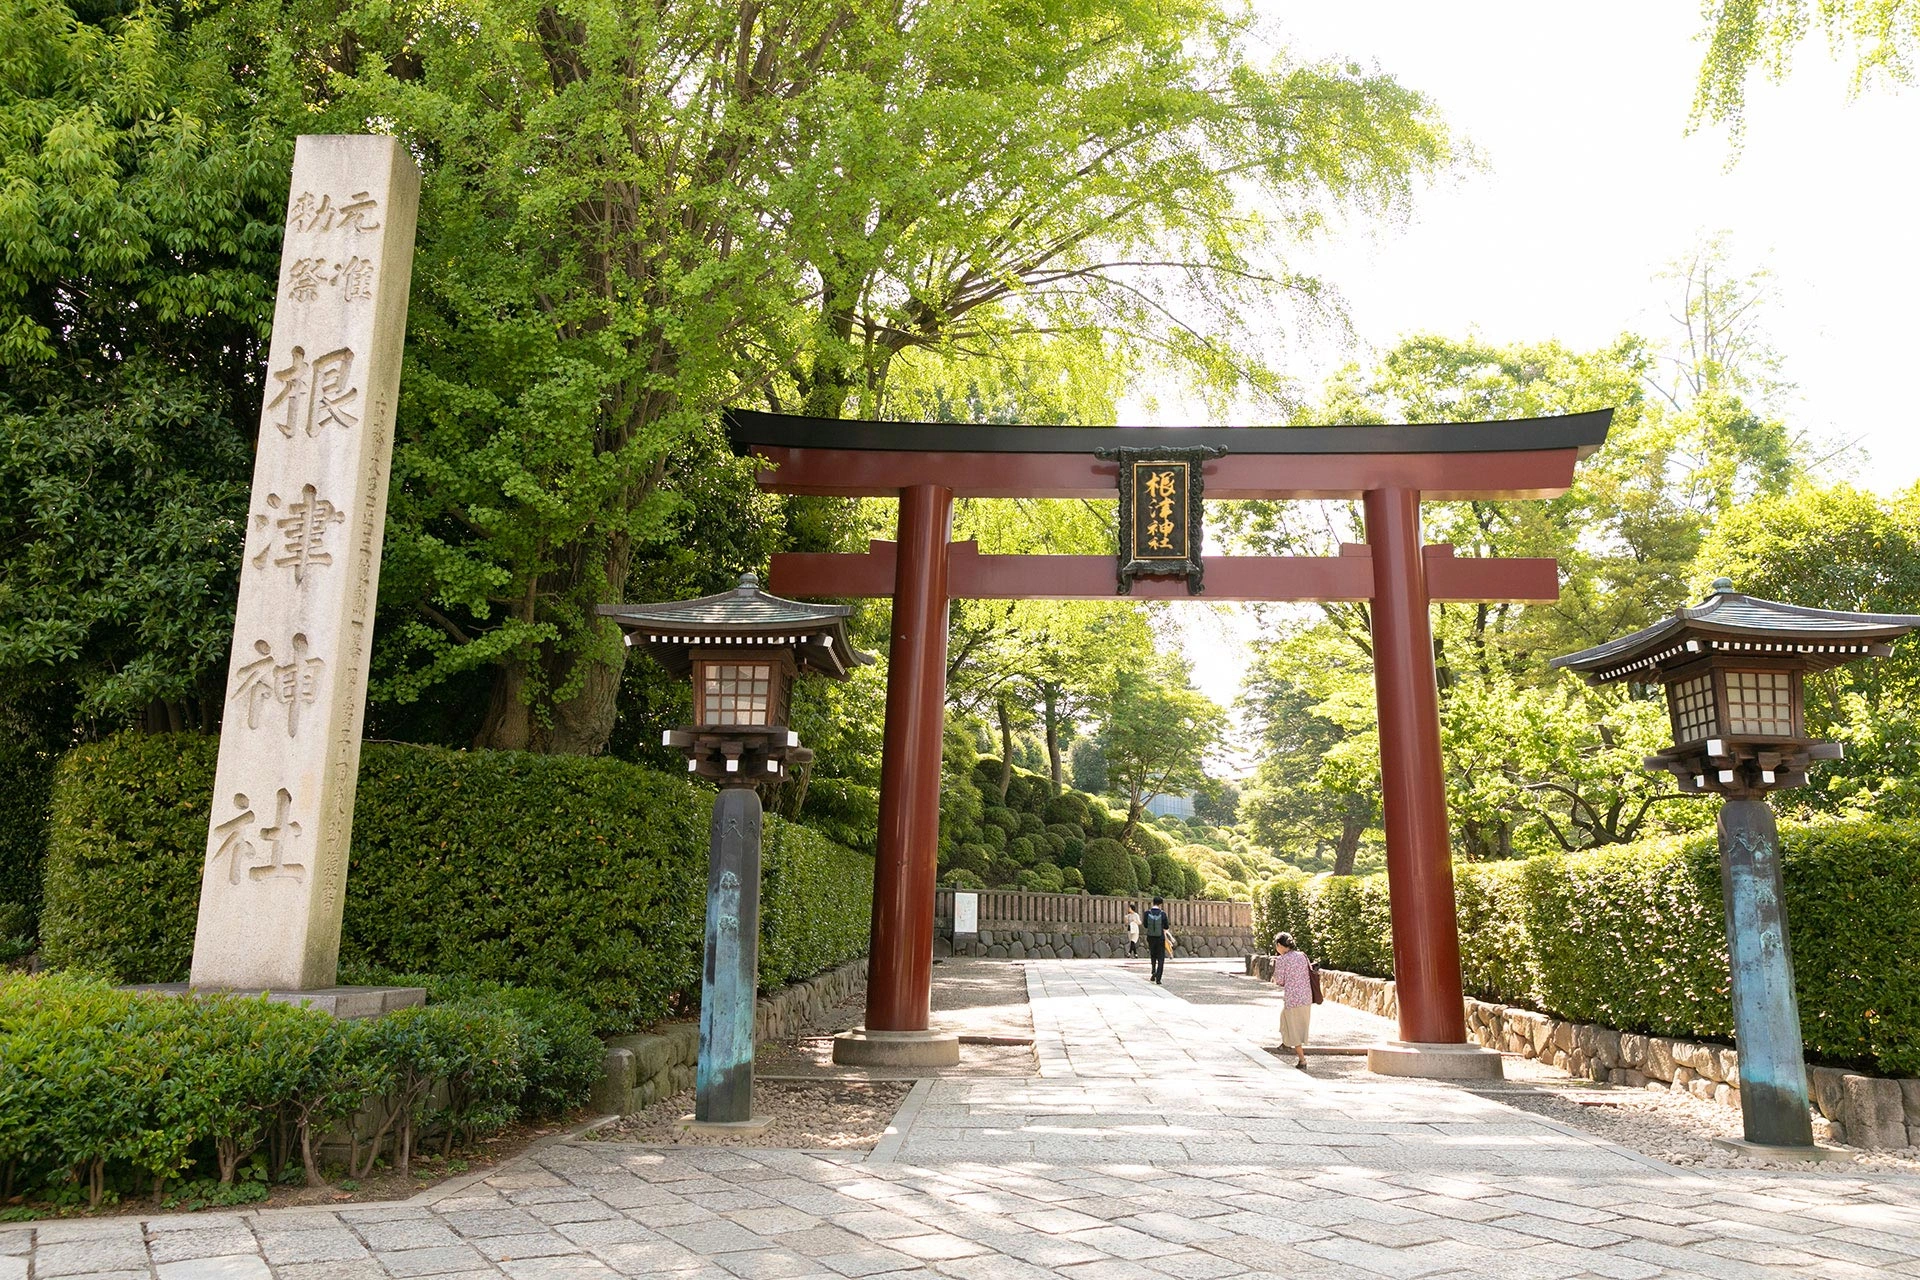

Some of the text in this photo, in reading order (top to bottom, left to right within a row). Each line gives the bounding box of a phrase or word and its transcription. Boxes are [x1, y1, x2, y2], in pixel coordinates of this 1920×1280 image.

[211, 345, 358, 886] 根津神社
[1145, 471, 1176, 550] 根津神社
